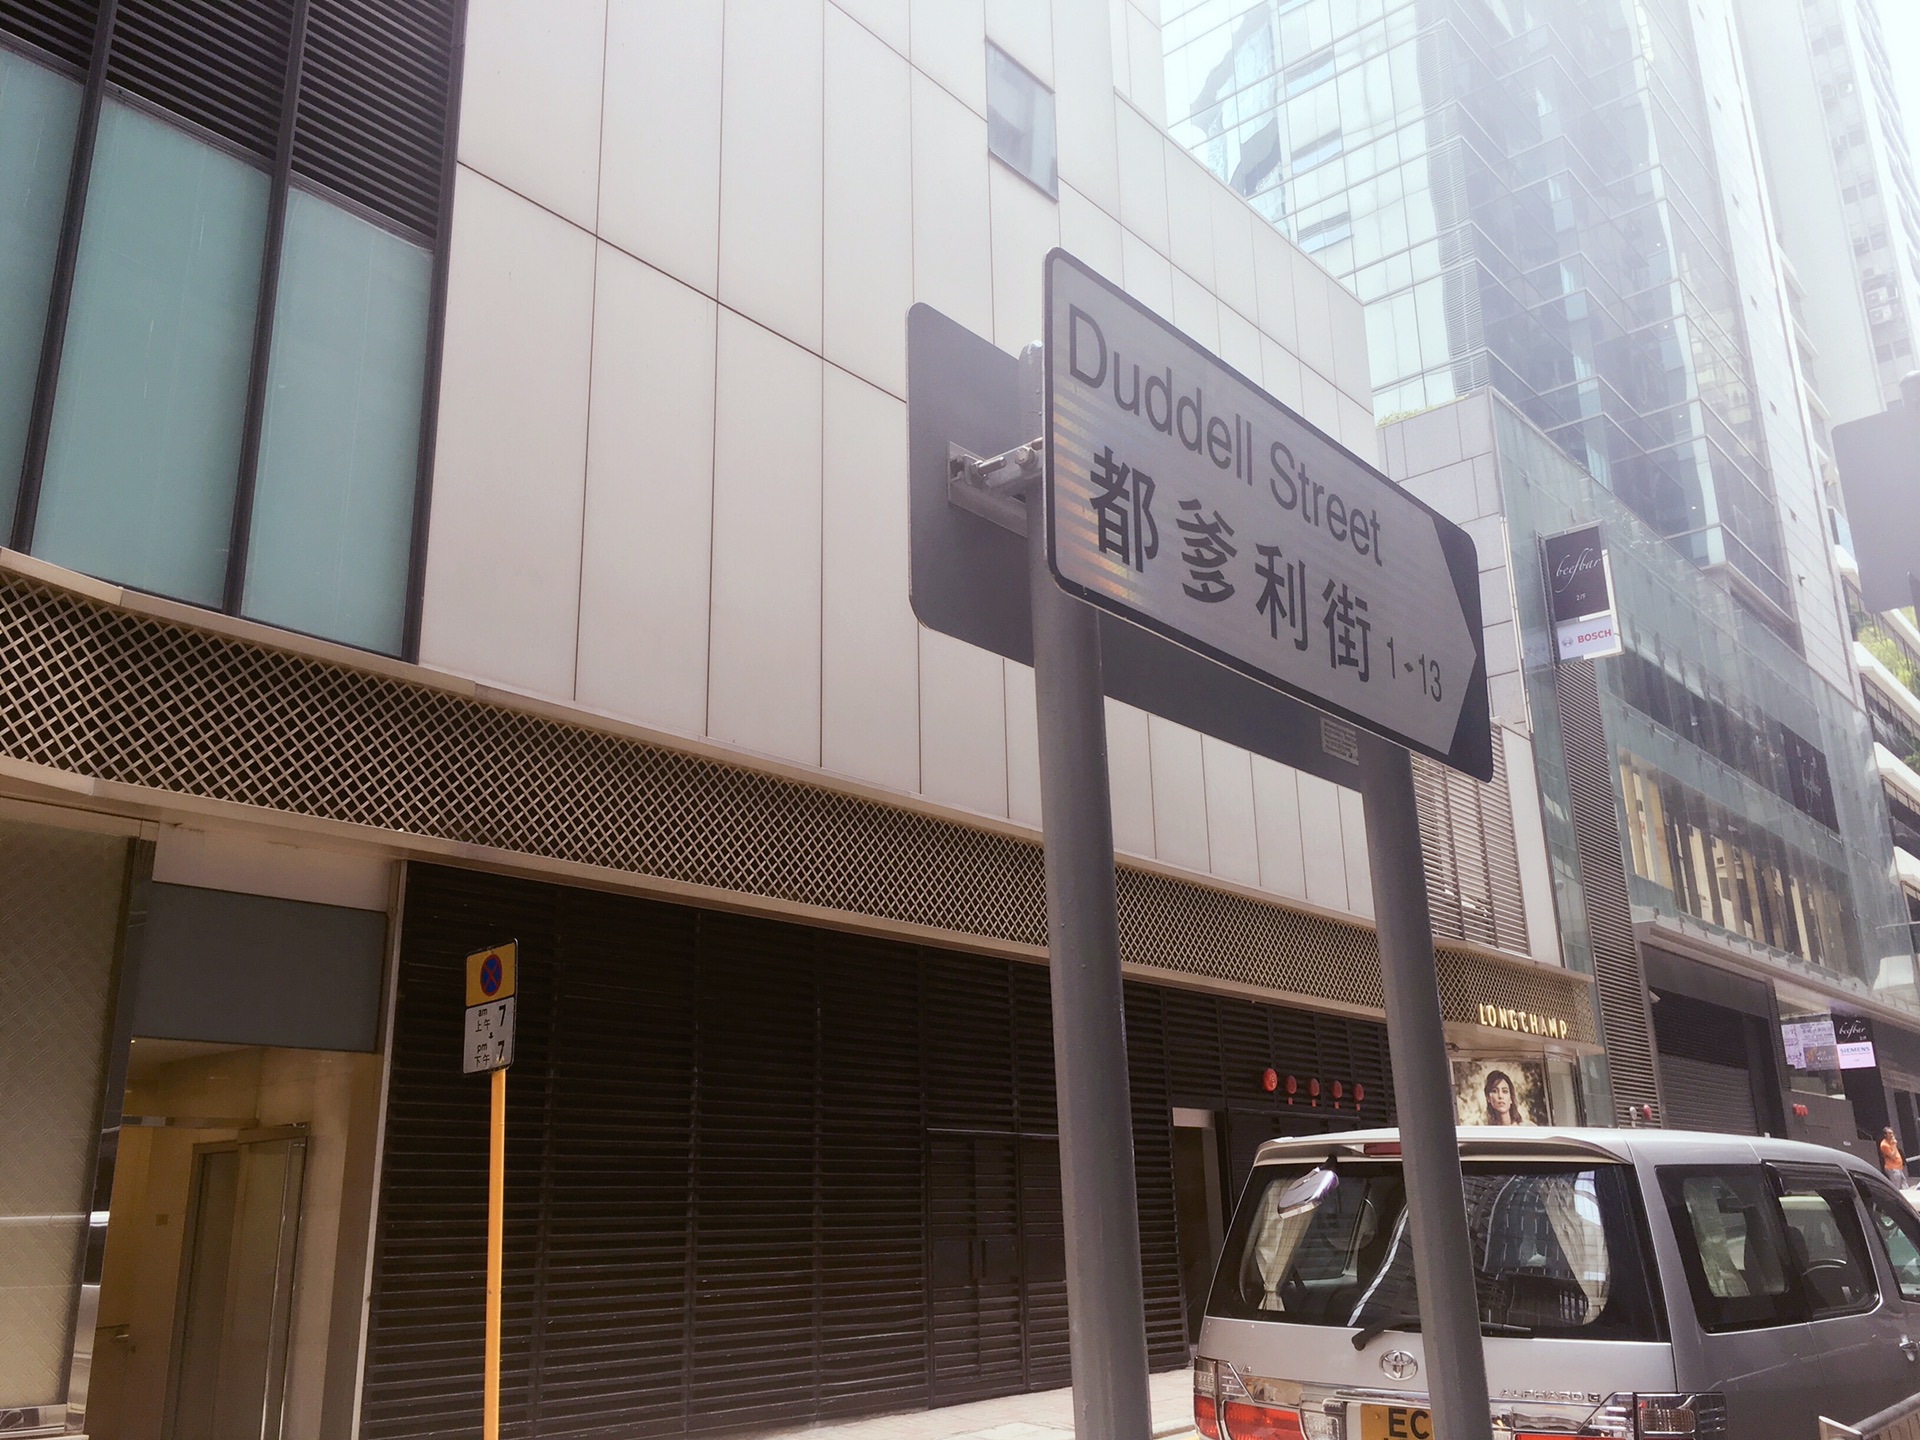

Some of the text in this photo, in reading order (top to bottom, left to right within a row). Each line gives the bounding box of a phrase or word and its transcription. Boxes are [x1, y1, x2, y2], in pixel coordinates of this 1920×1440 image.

[1069, 305, 1382, 567] Duddell Street
[1089, 446, 1372, 683] 都爹利街
[1555, 547, 1601, 593] beefbar
[1578, 628, 1612, 643] BOSCH
[478, 1008, 488, 1017] am
[499, 1004, 506, 1027] 7
[1479, 1003, 1568, 1039] LONGCHAMP
[475, 1019, 491, 1032] 上午
[477, 1043, 487, 1054] pm
[497, 1040, 505, 1061] 7
[474, 1054, 490, 1067] 下午
[1500, 1388, 1585, 1401] ALPHARD
[1388, 1407, 1430, 1440] EC
